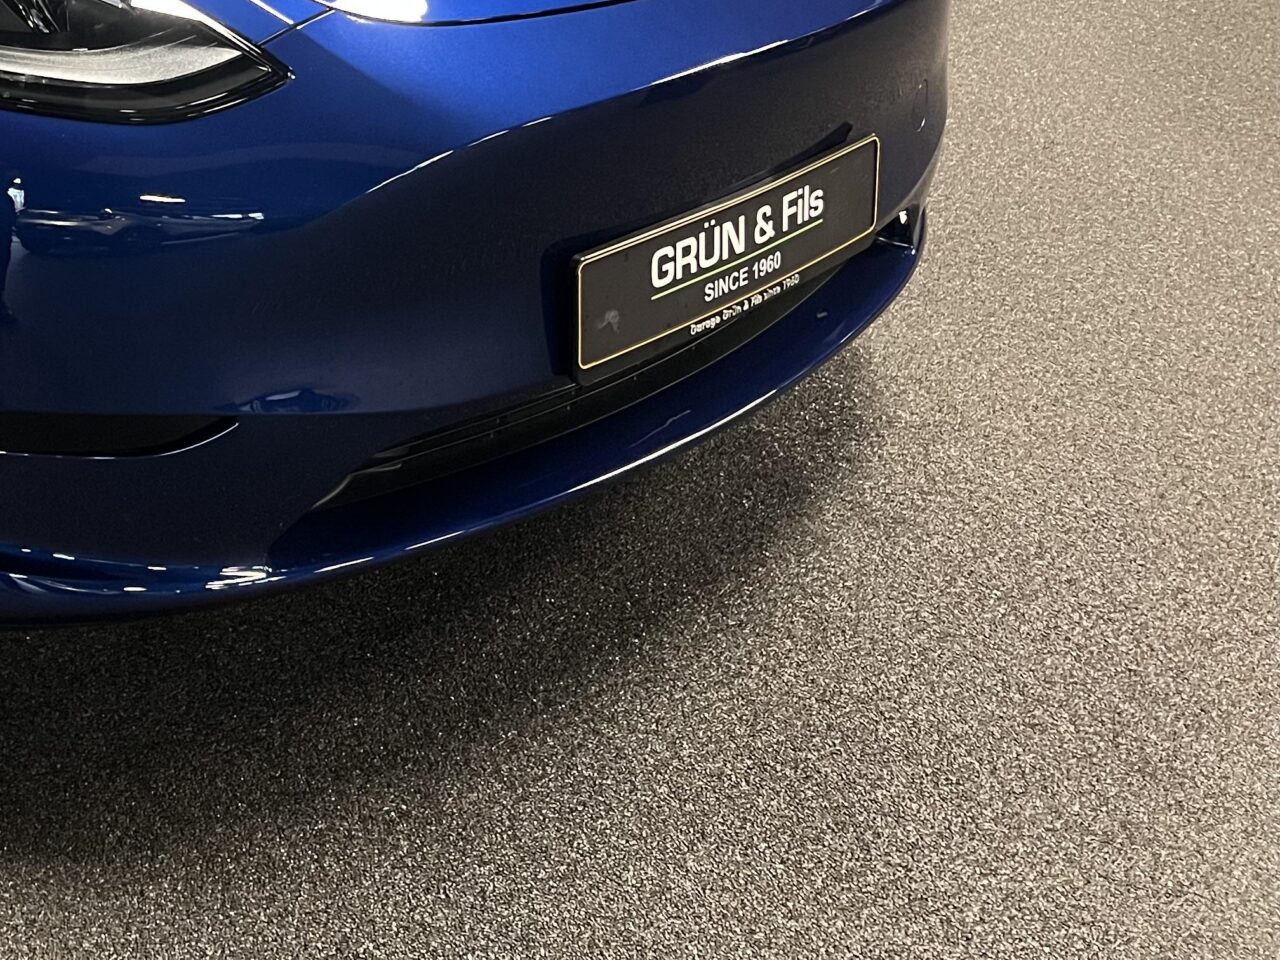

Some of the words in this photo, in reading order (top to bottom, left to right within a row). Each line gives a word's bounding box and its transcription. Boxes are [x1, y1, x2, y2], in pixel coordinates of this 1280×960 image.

[651, 215, 745, 288] GRÜN
[754, 205, 775, 244] &
[782, 185, 824, 232] Fils
[704, 266, 749, 302] SINCE
[752, 251, 781, 279] 1960
